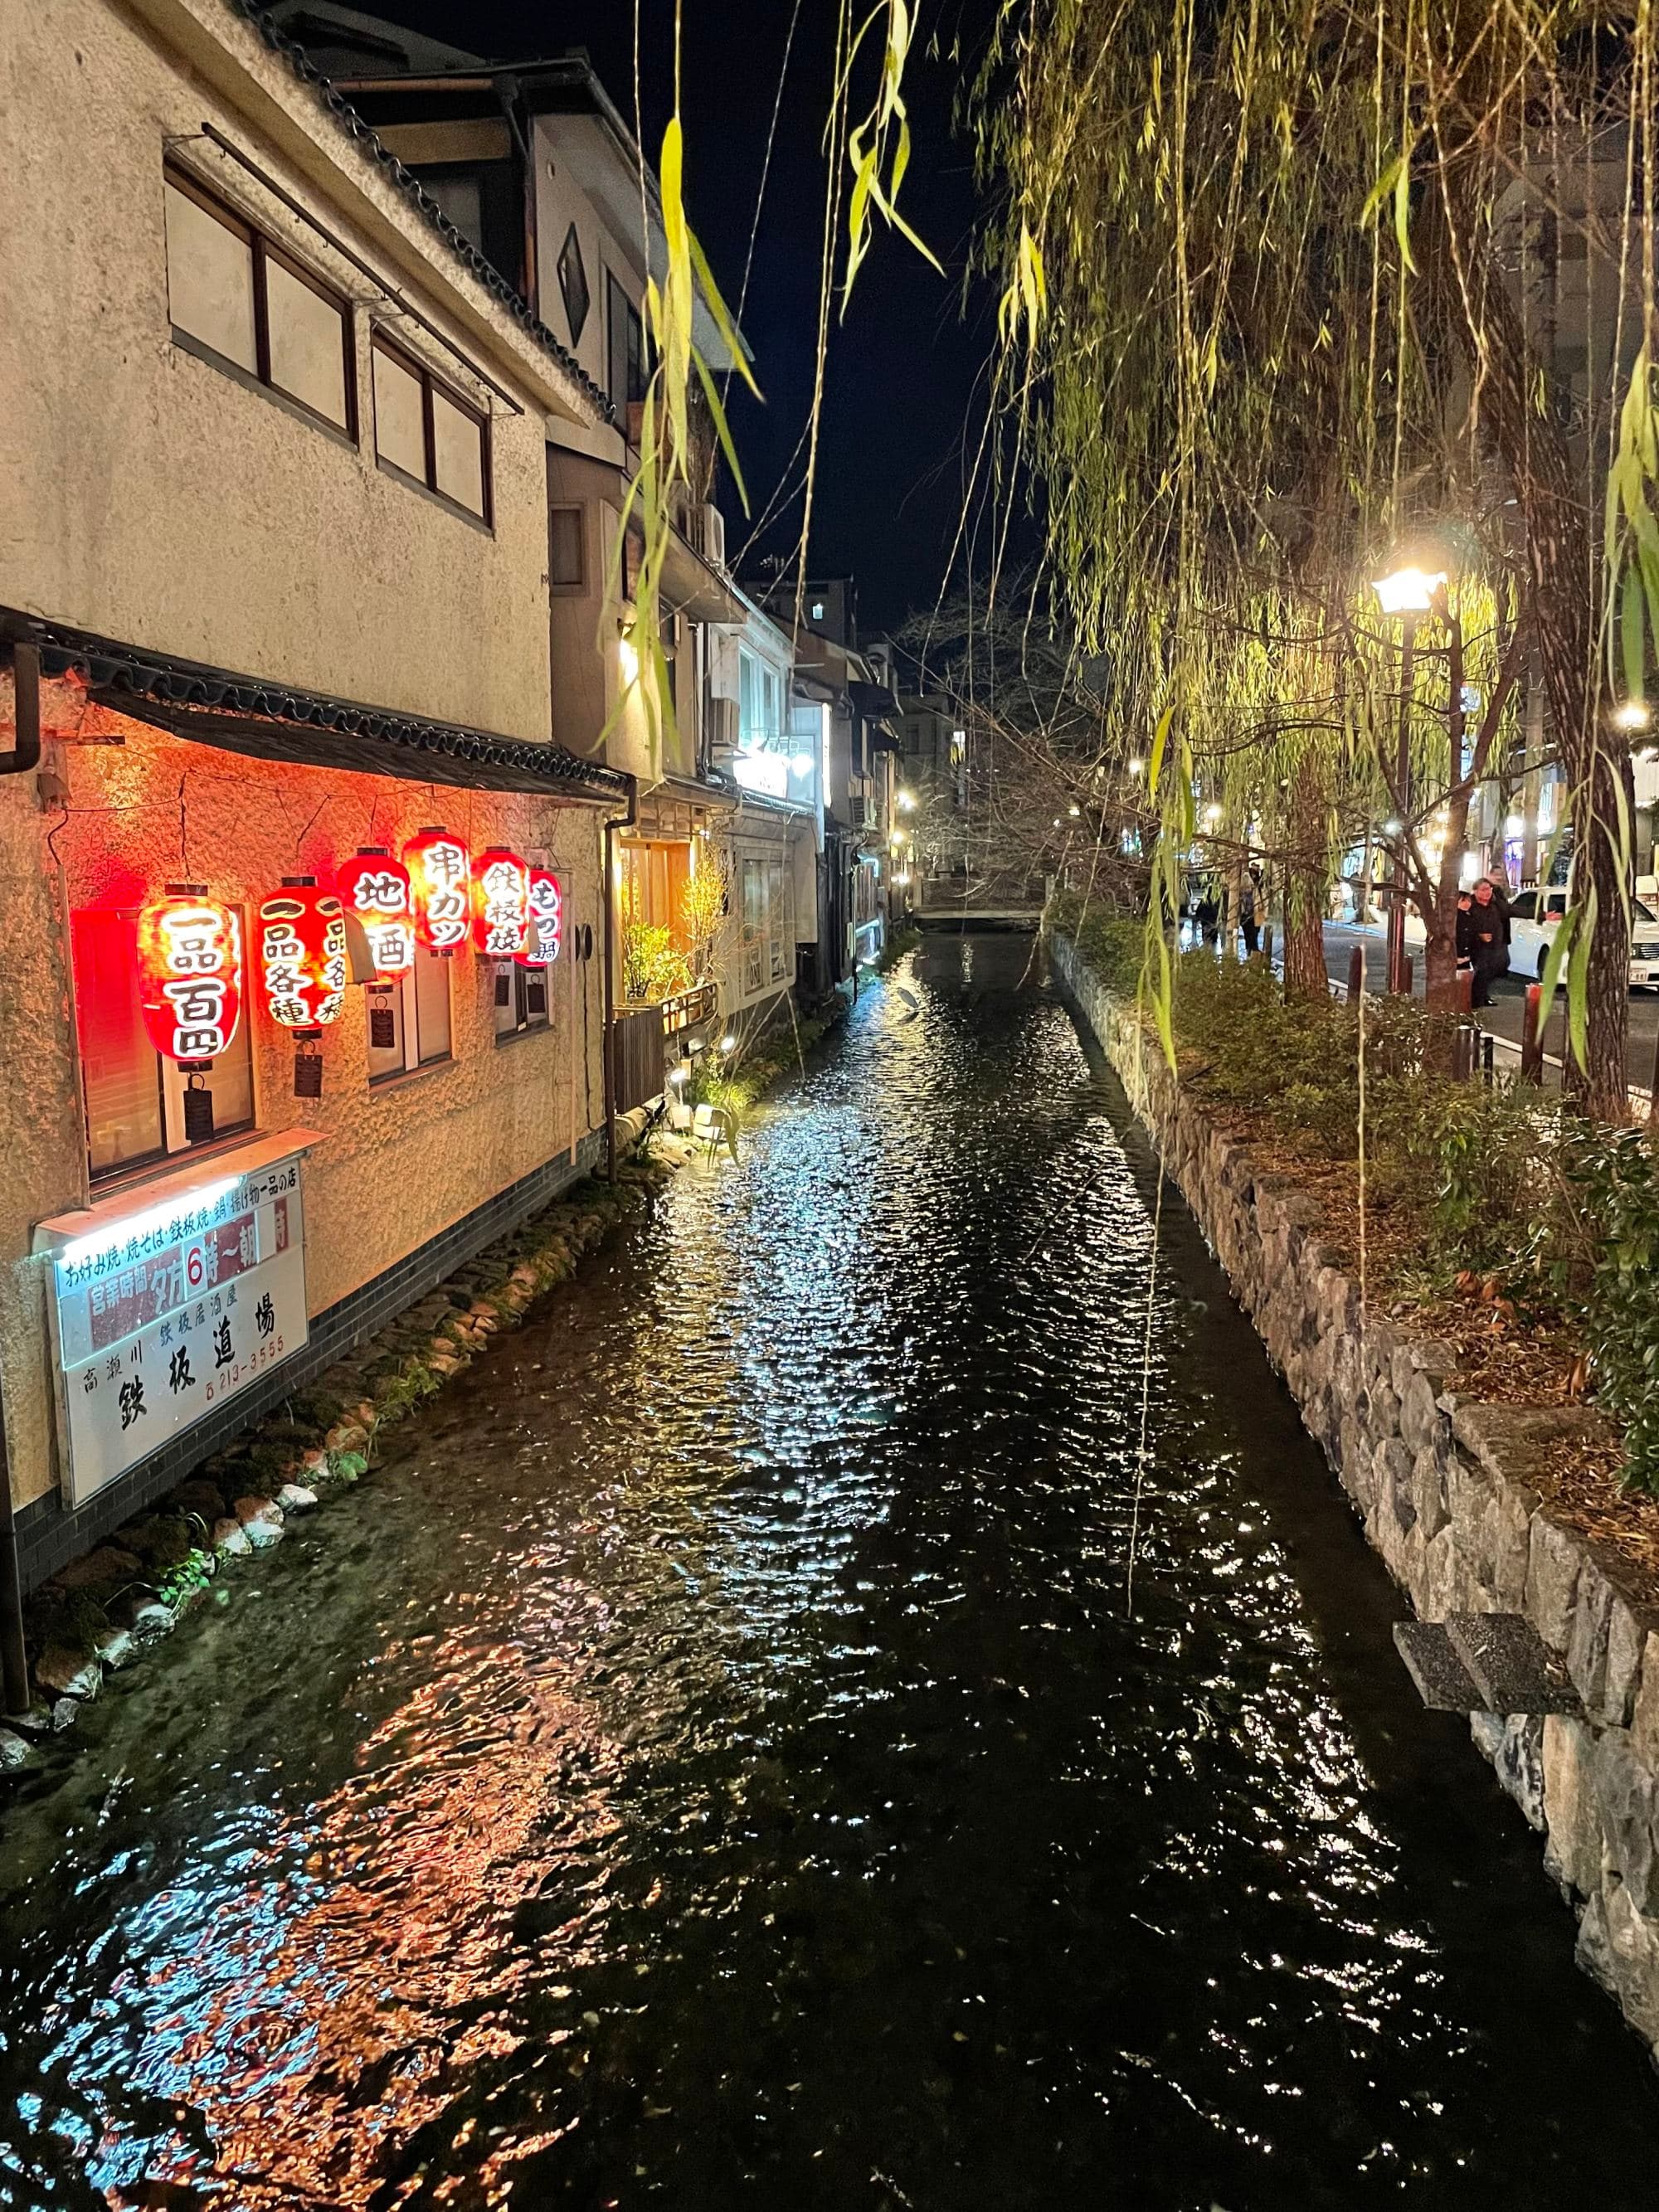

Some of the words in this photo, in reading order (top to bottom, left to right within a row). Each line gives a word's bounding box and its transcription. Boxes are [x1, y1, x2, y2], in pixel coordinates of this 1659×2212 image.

[358, 875, 405, 965] 地酒
[428, 845, 462, 944] 串カツ
[487, 865, 521, 951] 鉄板焼
[532, 882, 556, 960] もつ鍋
[168, 916, 221, 1055] 一品百円
[262, 901, 306, 1025] 一品各種
[83, 1339, 143, 1394] 高瀬川
[159, 1284, 239, 1347] 鉄板居酒屋
[91, 1266, 148, 1316] 営業時間
[118, 1291, 275, 1432] 鉄板道場
